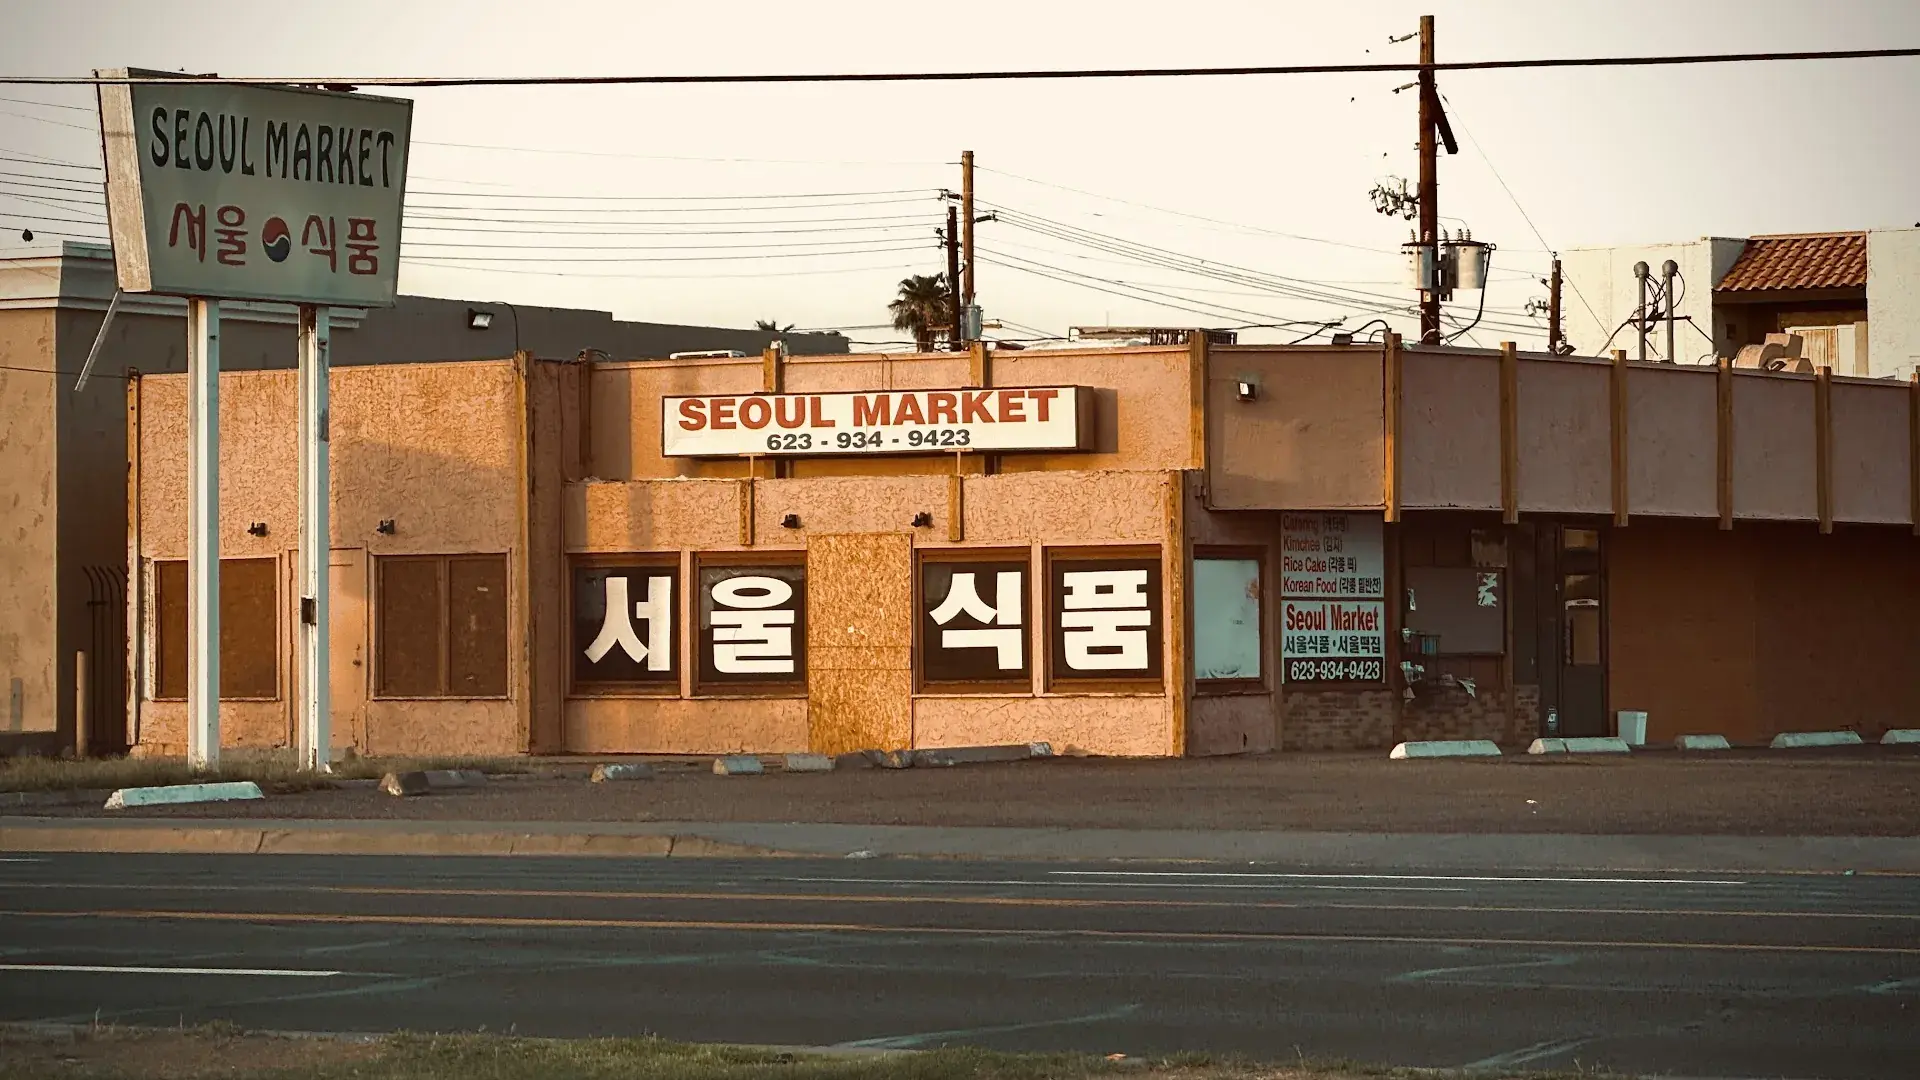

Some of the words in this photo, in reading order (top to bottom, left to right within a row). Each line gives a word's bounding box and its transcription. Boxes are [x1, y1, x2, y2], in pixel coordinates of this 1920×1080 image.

[151, 107, 254, 176] SEOUL
[266, 120, 394, 188] MARKET
[169, 203, 248, 266] 서울
[301, 214, 380, 275] 식품
[678, 396, 836, 431] SEOUL
[852, 389, 1059, 427] MARKET
[1283, 536, 1321, 552] Kimchee
[1283, 556, 1303, 572] Rice
[1305, 556, 1327, 572] Cake
[1283, 576, 1313, 593] Korean
[1316, 577, 1337, 593] Food
[1286, 603, 1326, 631] Seoul
[1330, 604, 1379, 631] Market
[1291, 660, 1380, 680] 623-934-9423
